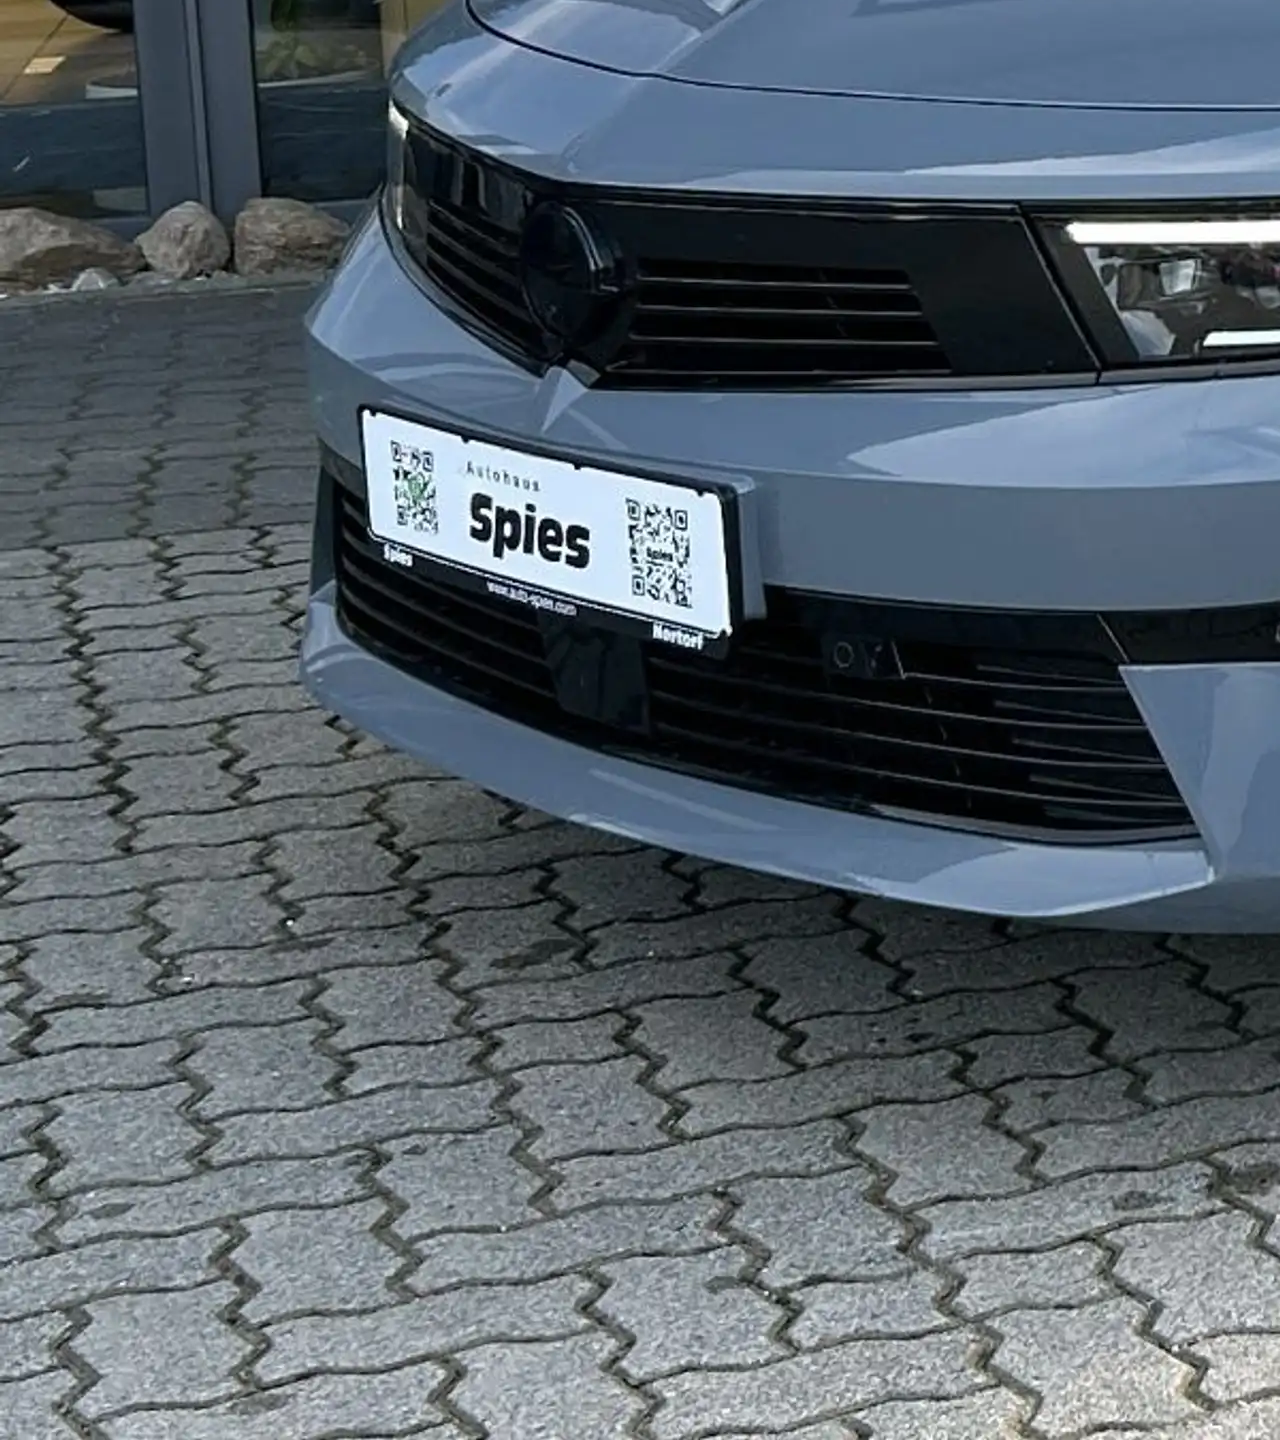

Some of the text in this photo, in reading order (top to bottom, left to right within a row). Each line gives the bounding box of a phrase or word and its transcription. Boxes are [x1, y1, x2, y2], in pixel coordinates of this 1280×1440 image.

[465, 461, 540, 492] Autohaus
[469, 492, 591, 570] Spies
[383, 543, 414, 568] Spies
